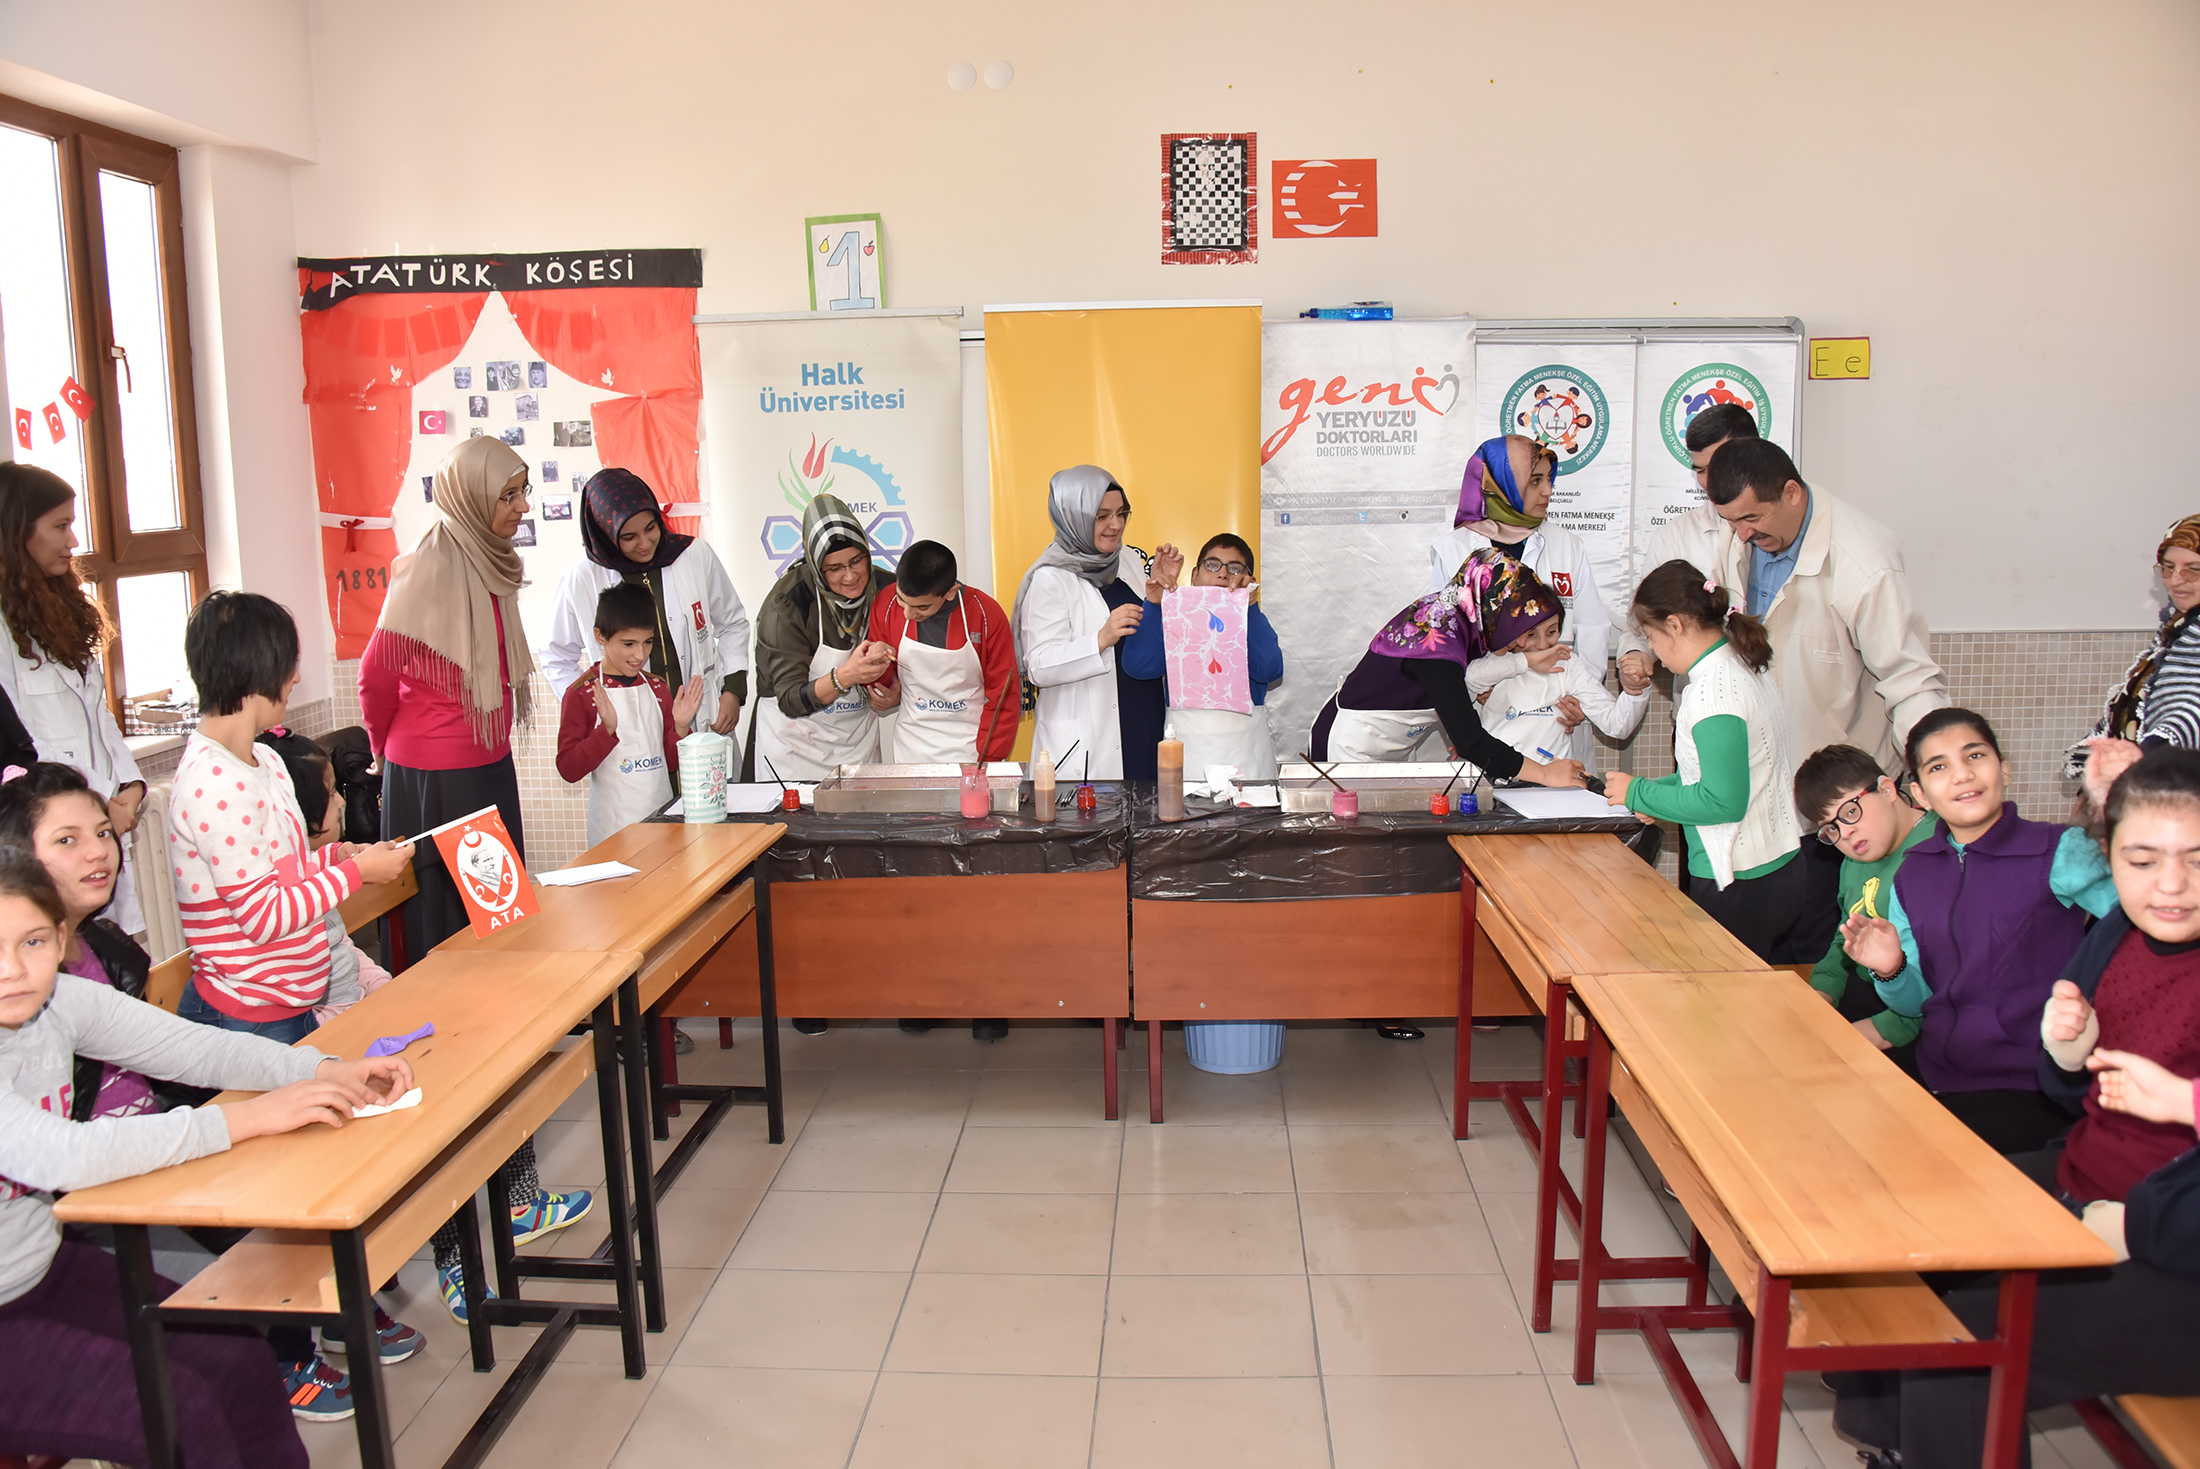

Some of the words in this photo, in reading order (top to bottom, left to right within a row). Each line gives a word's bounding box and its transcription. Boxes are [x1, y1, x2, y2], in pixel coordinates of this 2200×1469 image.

[330, 258, 492, 298] ATATÜRK
[526, 253, 634, 285] KÖŞESİ
[1816, 346, 1829, 376] E
[801, 362, 864, 387] Halk
[1515, 378, 1534, 395] FATMA
[1566, 371, 1583, 384] ÖZEL
[1672, 379, 1692, 397] FATMA
[1725, 370, 1743, 381] ÖZEL
[760, 387, 905, 413] Üniversitesi
[1316, 430, 1418, 444] DOKTORLARI
[1316, 446, 1358, 457] DOCTORS
[1361, 445, 1416, 456] WORLDWIDE
[1578, 523, 1607, 531] MERKEZİ
[1584, 512, 1615, 521] MENEKŞE
[336, 566, 388, 592] 1881
[929, 699, 966, 710] KOMEK
[490, 906, 525, 930] ATA
